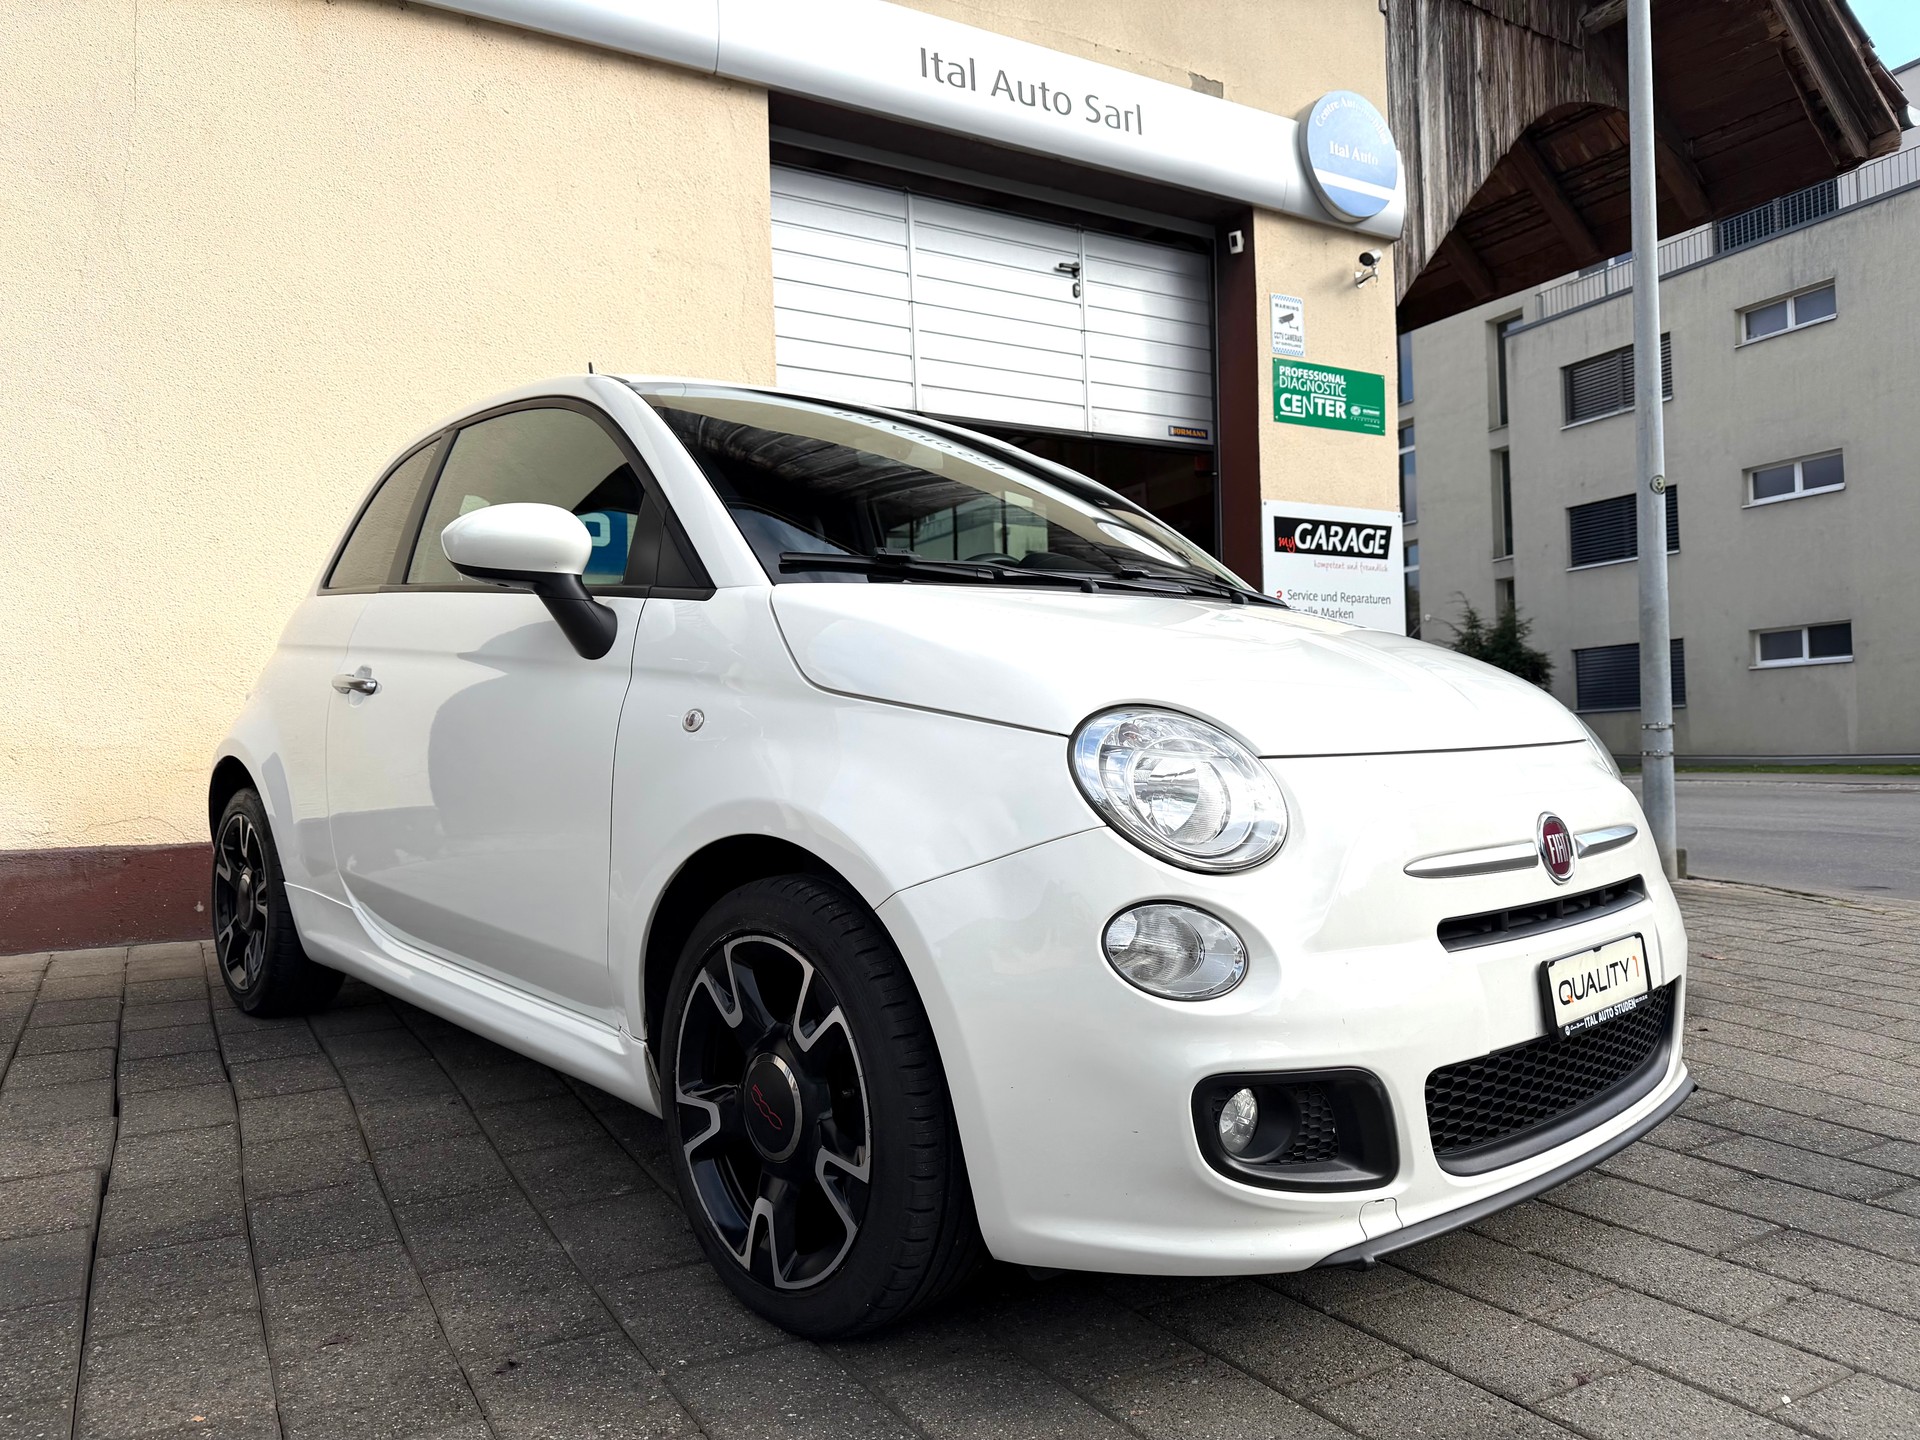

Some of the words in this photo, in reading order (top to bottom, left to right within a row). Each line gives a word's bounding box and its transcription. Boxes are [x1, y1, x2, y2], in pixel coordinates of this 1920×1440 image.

[920, 47, 976, 92] Ital
[991, 69, 1072, 116] Auto
[1085, 94, 1142, 135] Sarl
[1315, 101, 1339, 127] Centre
[1330, 141, 1350, 158] Ital
[1352, 147, 1378, 165] Auto
[1279, 366, 1346, 385] PROFESSIONAL
[1279, 376, 1346, 397] DIAGNOSTIC
[1279, 393, 1347, 419] CENTER
[1287, 589, 1318, 600] Service
[1320, 591, 1338, 602] und
[1340, 592, 1391, 605] Reparaturen
[1320, 607, 1354, 619] Marken
[1546, 833, 1570, 864] FIAT
[1583, 1013, 1598, 1028] ITAL
[1598, 1008, 1614, 1022] AUTO
[1614, 997, 1637, 1016] STUDEN
